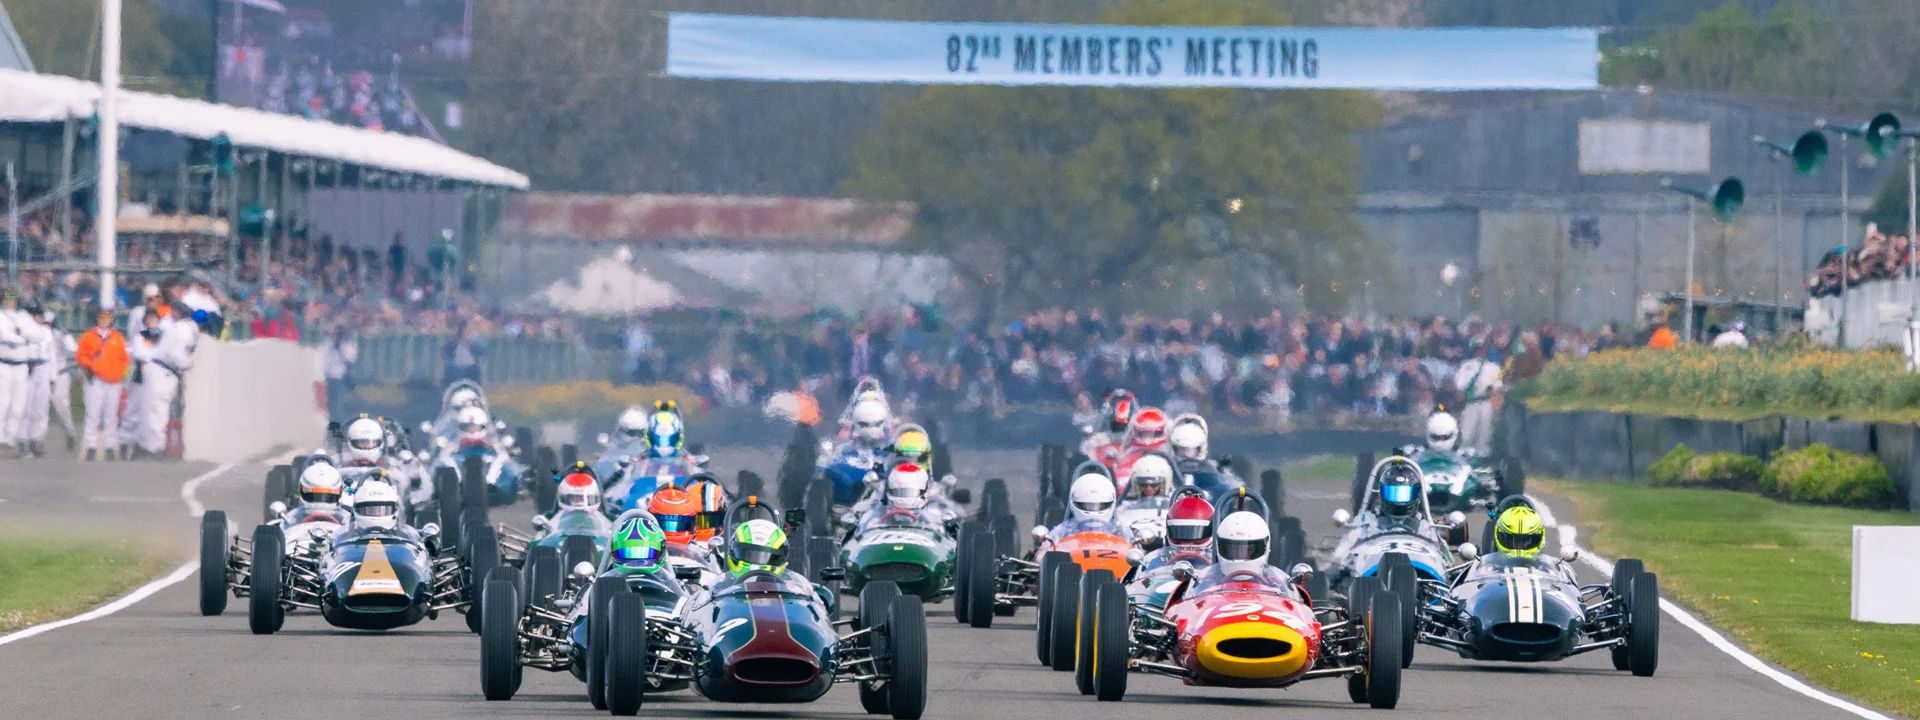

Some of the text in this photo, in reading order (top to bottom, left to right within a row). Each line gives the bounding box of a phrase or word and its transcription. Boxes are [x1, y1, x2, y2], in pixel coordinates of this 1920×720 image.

[1013, 35, 1173, 76] MEMBERS'
[1184, 37, 1318, 79] MEETING
[1082, 549, 1119, 559] 12
